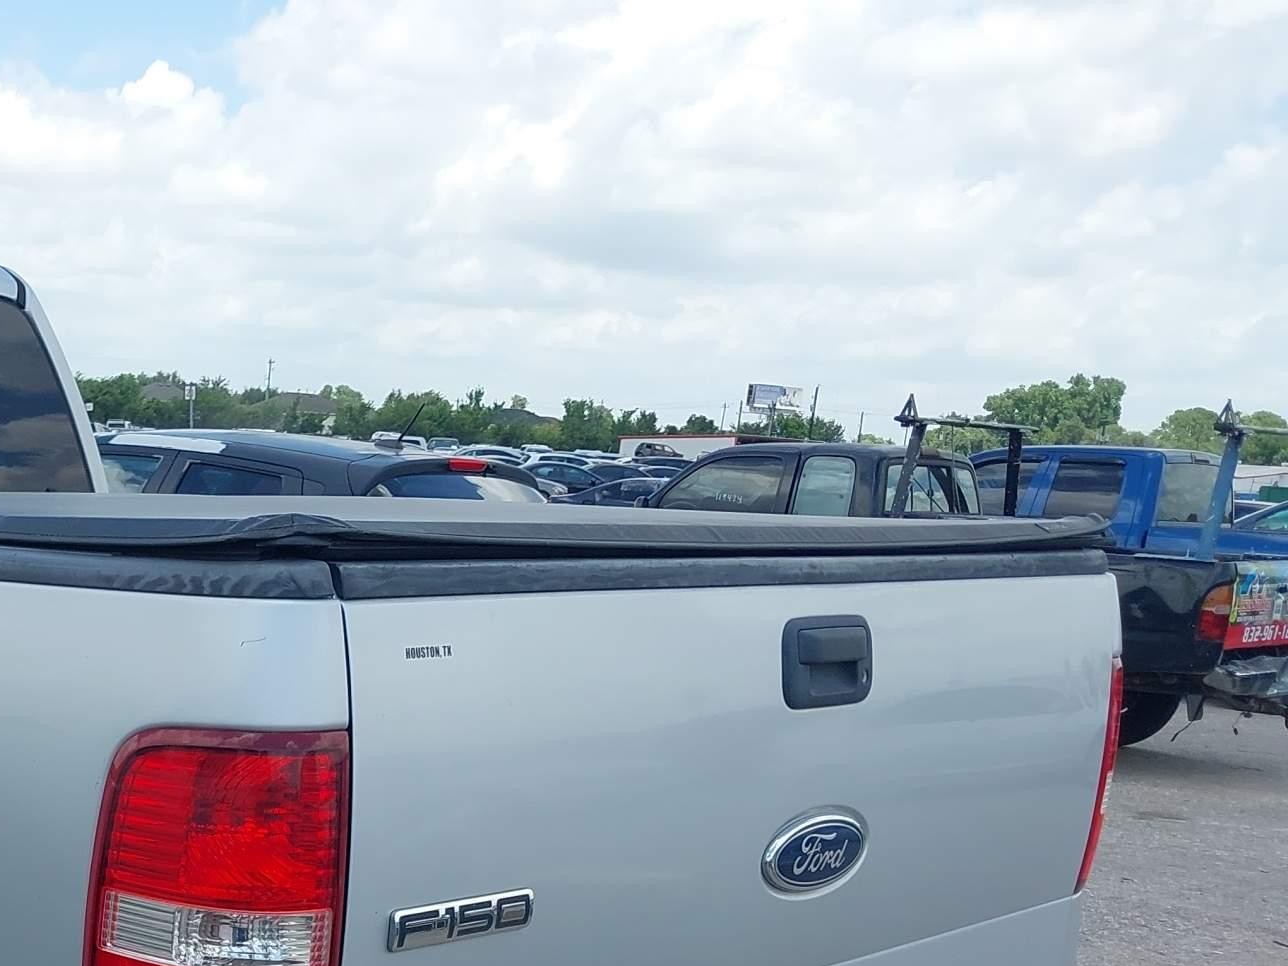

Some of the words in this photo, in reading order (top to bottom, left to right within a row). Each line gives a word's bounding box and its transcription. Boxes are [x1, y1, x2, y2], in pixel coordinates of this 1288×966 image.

[442, 645, 452, 657] TX
[793, 832, 848, 875] Ford
[396, 893, 531, 949] F-150
